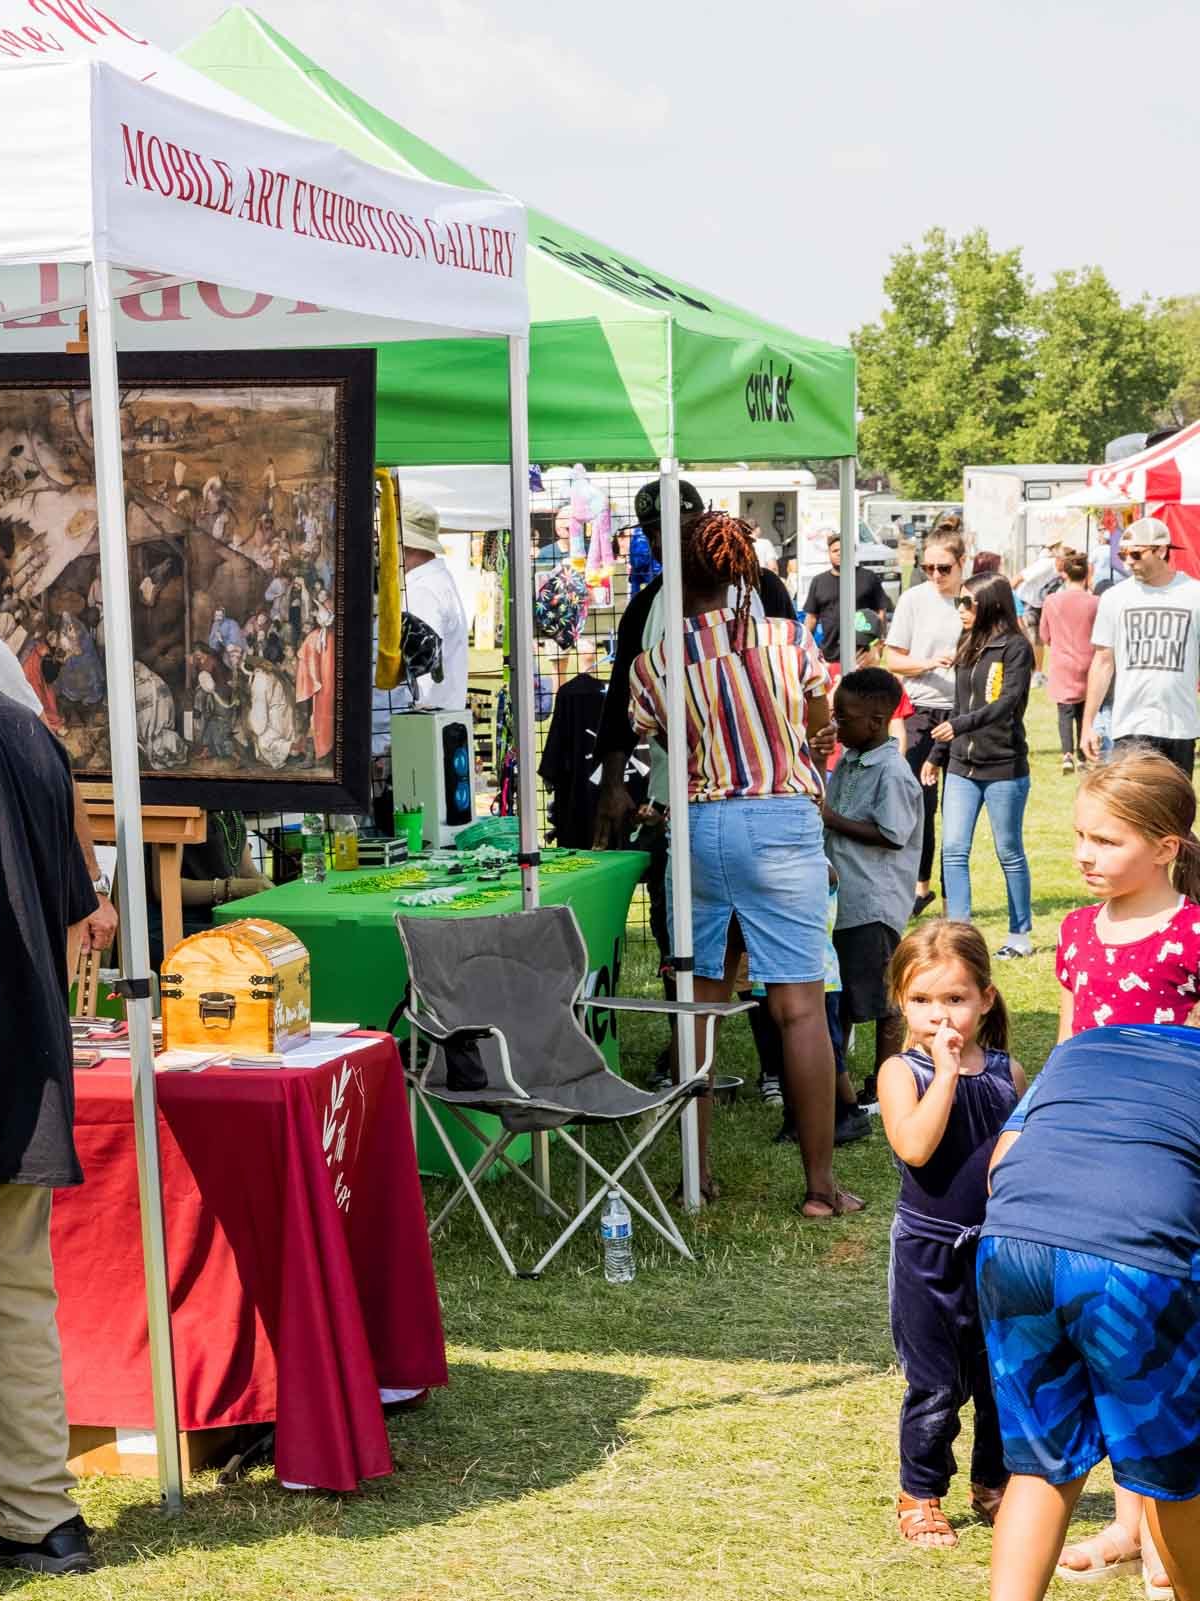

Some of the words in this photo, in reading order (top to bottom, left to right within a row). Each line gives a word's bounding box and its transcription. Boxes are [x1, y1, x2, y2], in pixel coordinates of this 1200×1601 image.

[120, 122, 235, 216] MOBILE
[238, 167, 290, 231] ART
[293, 179, 428, 259] EXHIBITION
[424, 218, 517, 279] GALLERY
[1130, 612, 1186, 641] ROOT
[1129, 640, 1182, 667] DOWN
